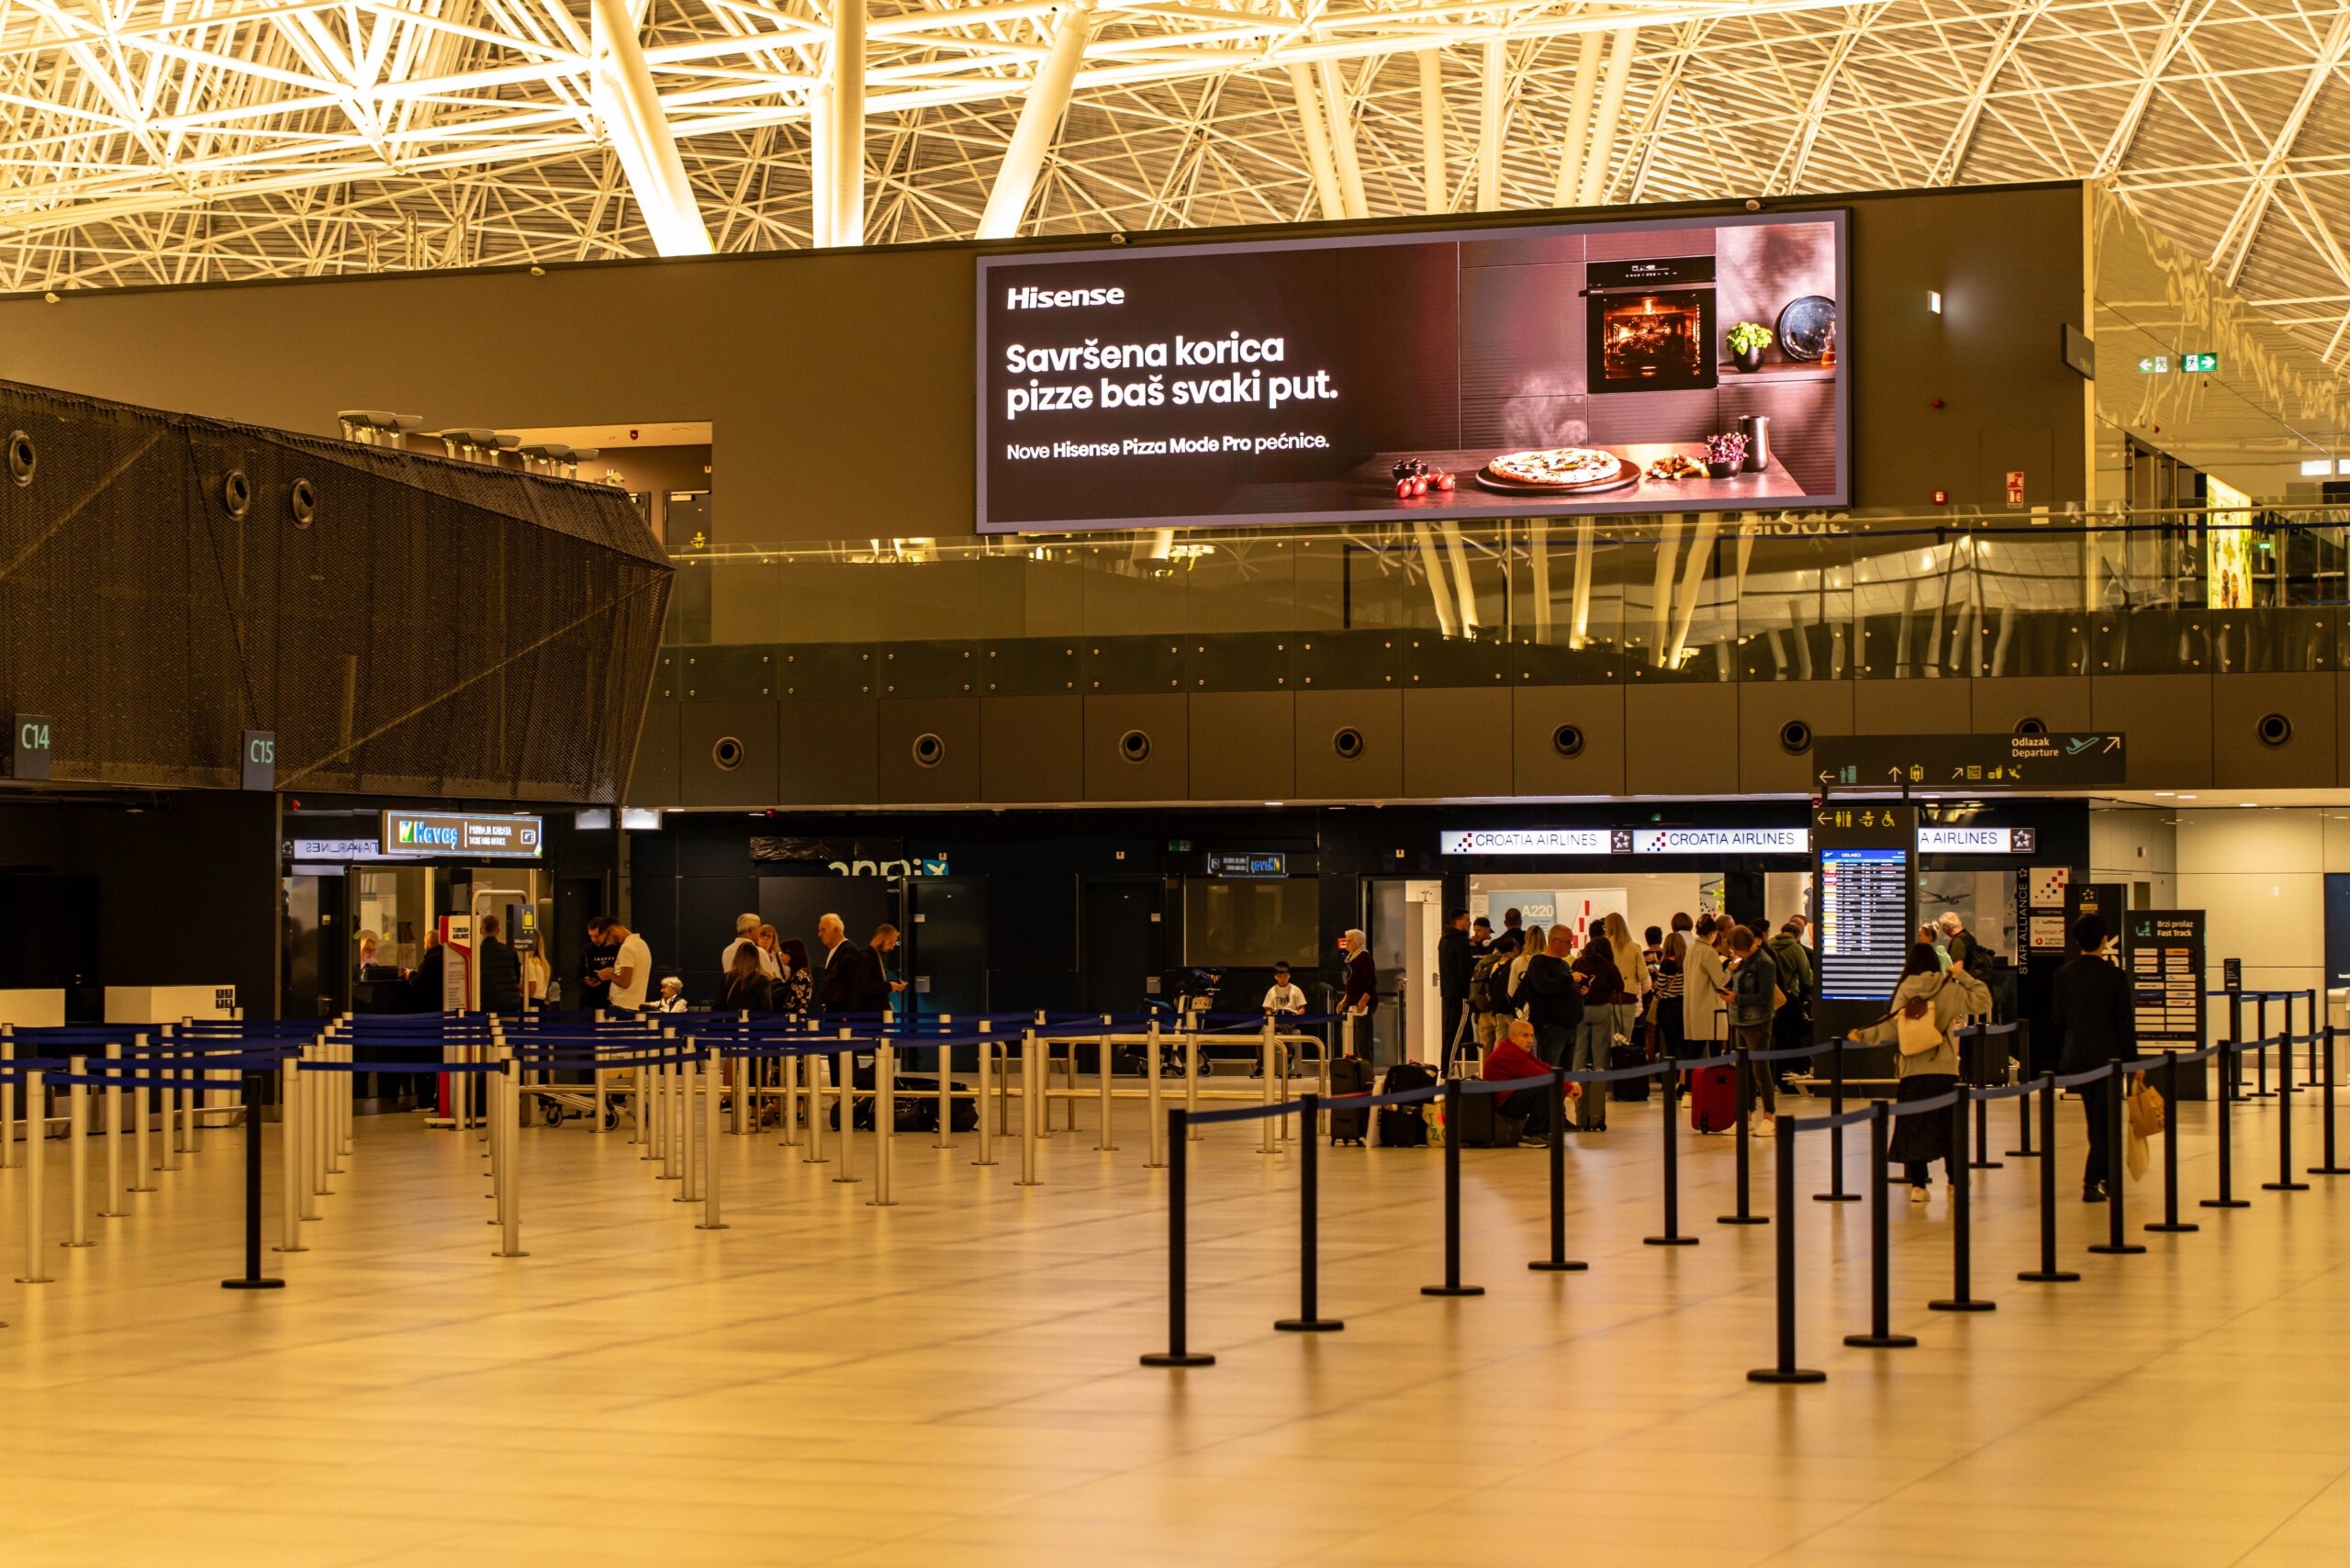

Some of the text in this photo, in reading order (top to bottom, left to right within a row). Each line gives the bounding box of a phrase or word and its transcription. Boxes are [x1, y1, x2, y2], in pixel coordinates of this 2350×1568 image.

[1007, 286, 1125, 310] Hisense
[1006, 330, 1284, 374] Savršena korica
[1007, 369, 1338, 420] pizze baš svaki put.
[1007, 431, 1330, 460] Nove Hisense Pizza Mode Pro pećnice.
[21, 723, 50, 749] C14
[2011, 737, 2050, 746] Odlazak
[250, 739, 274, 764] C15
[2011, 749, 2059, 758] Departure
[413, 821, 459, 850] Havaş
[1475, 834, 1597, 846] CROATIA AIRLINES
[1670, 833, 1795, 846] CROATIA AIRLINES
[1933, 832, 1998, 845] AIRLINES
[1521, 904, 1554, 917] A220
[2019, 883, 2028, 975] STAR ALLIANCE
